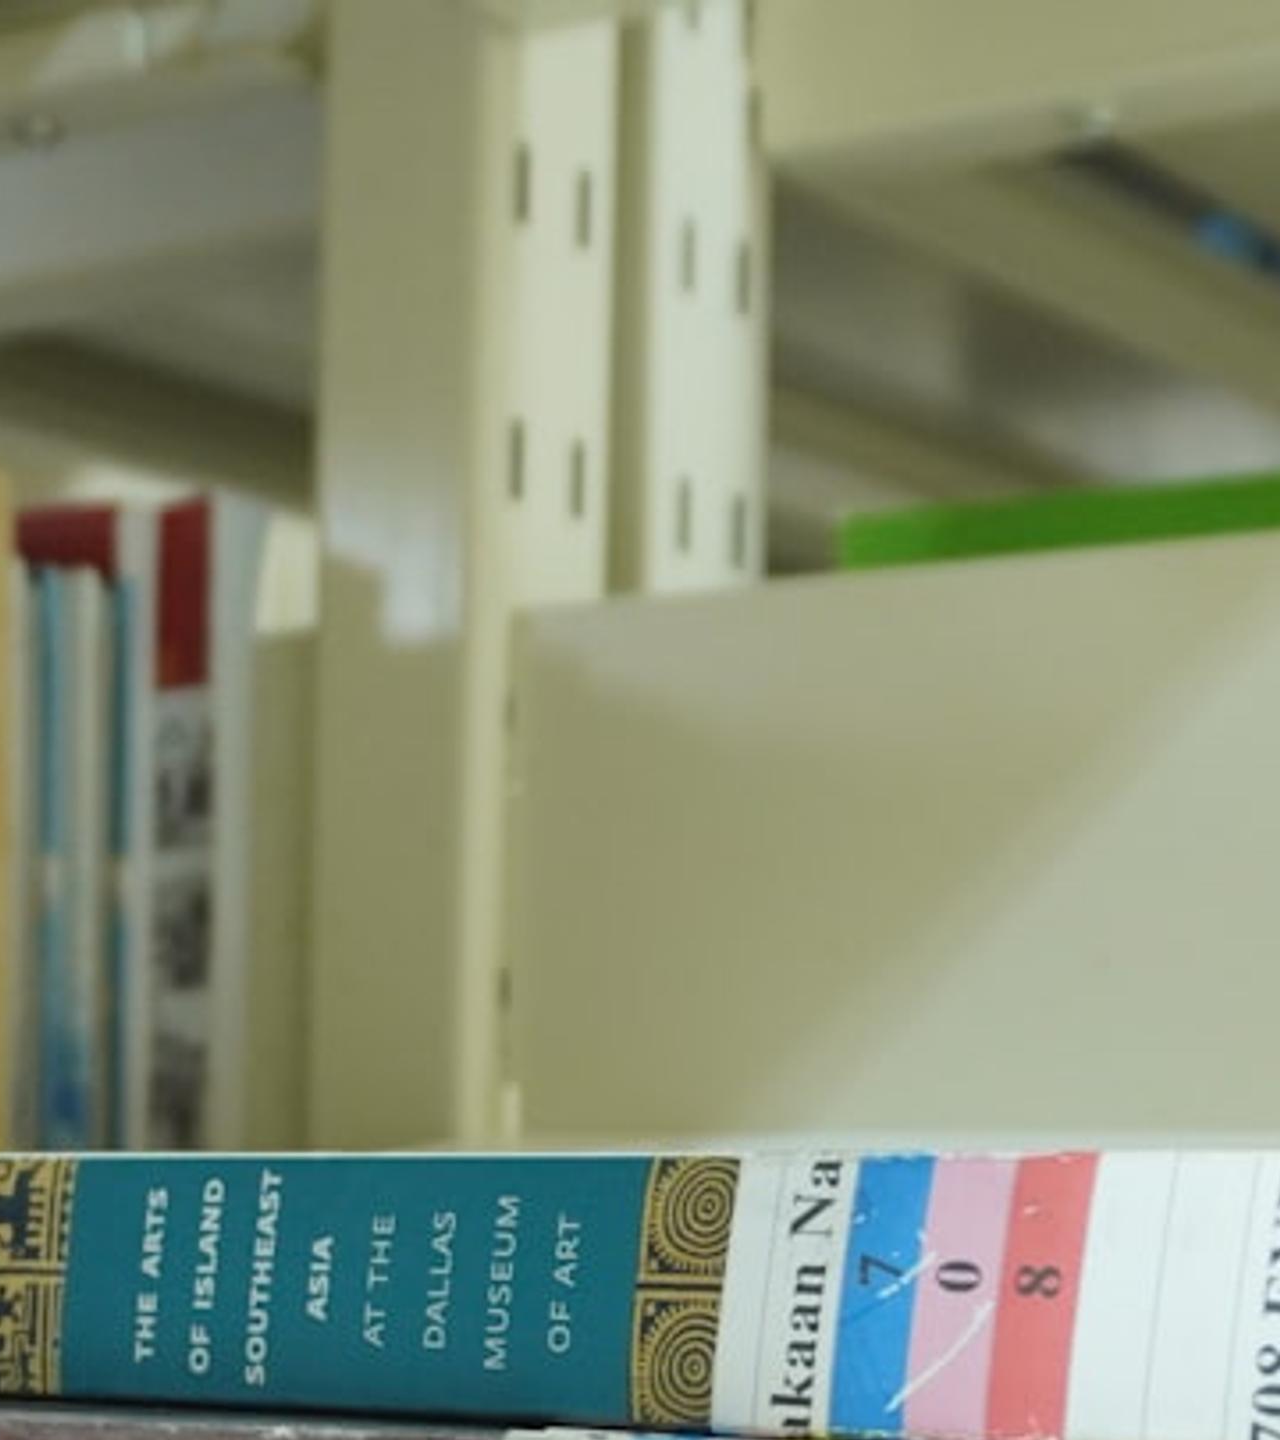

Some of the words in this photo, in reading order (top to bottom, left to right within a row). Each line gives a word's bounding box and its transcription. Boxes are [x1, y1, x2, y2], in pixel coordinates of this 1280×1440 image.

[142, 1187, 169, 1279] ARTS
[790, 1159, 844, 1239] Na
[193, 1178, 227, 1311] ISLAND
[245, 1168, 285, 1387] SOUTHEAST
[305, 1235, 336, 1322] ASIA
[369, 1213, 397, 1287] THE
[423, 1211, 458, 1350] DALLAS
[554, 1212, 582, 1288] ART
[858, 1254, 904, 1288] 7
[936, 1260, 983, 1294] 0
[1015, 1264, 1062, 1299] 8
[483, 1195, 521, 1371] MUSEUM
[134, 1292, 158, 1363] THE
[188, 1320, 212, 1374] OF
[362, 1304, 386, 1349] AT
[547, 1302, 574, 1355] OF
